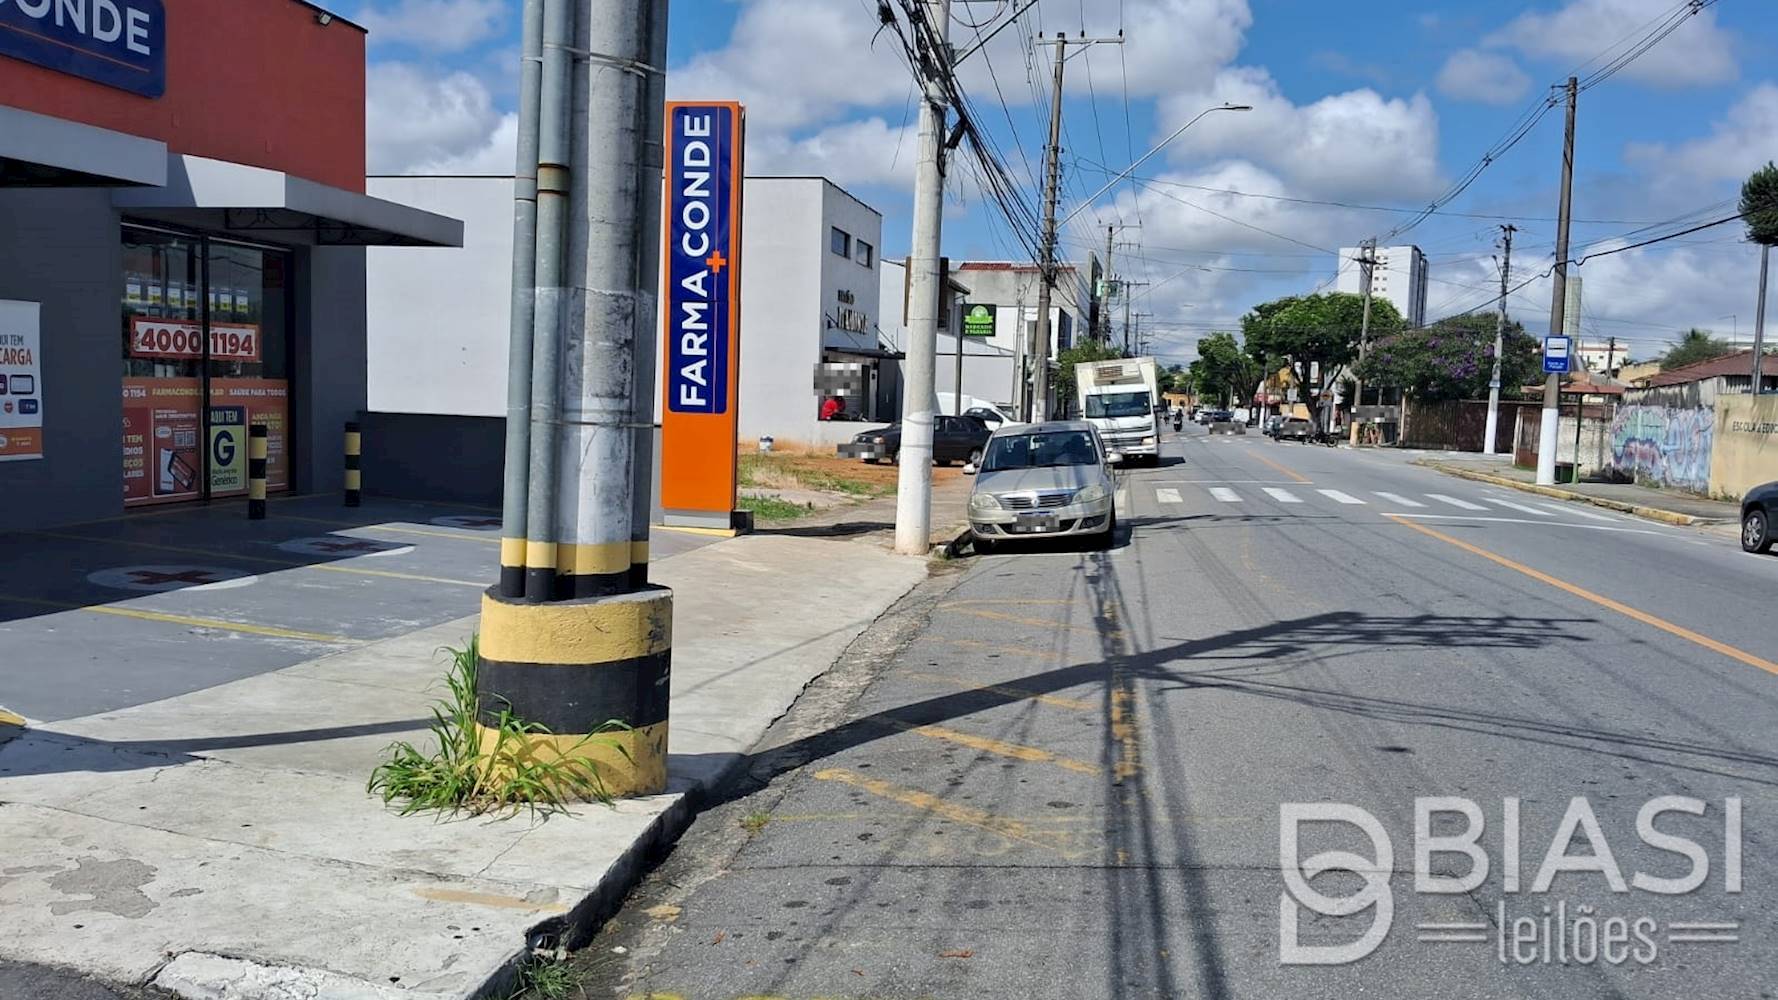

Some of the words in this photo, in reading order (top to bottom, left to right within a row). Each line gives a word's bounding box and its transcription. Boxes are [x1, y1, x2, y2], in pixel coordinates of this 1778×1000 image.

[0, 0, 150, 56] NDE
[682, 114, 711, 258] CONDE
[141, 328, 201, 353] 4000
[210, 332, 253, 355] 1194
[681, 270, 709, 406] FARMA
[224, 410, 238, 424] TEM
[213, 430, 235, 467] G
